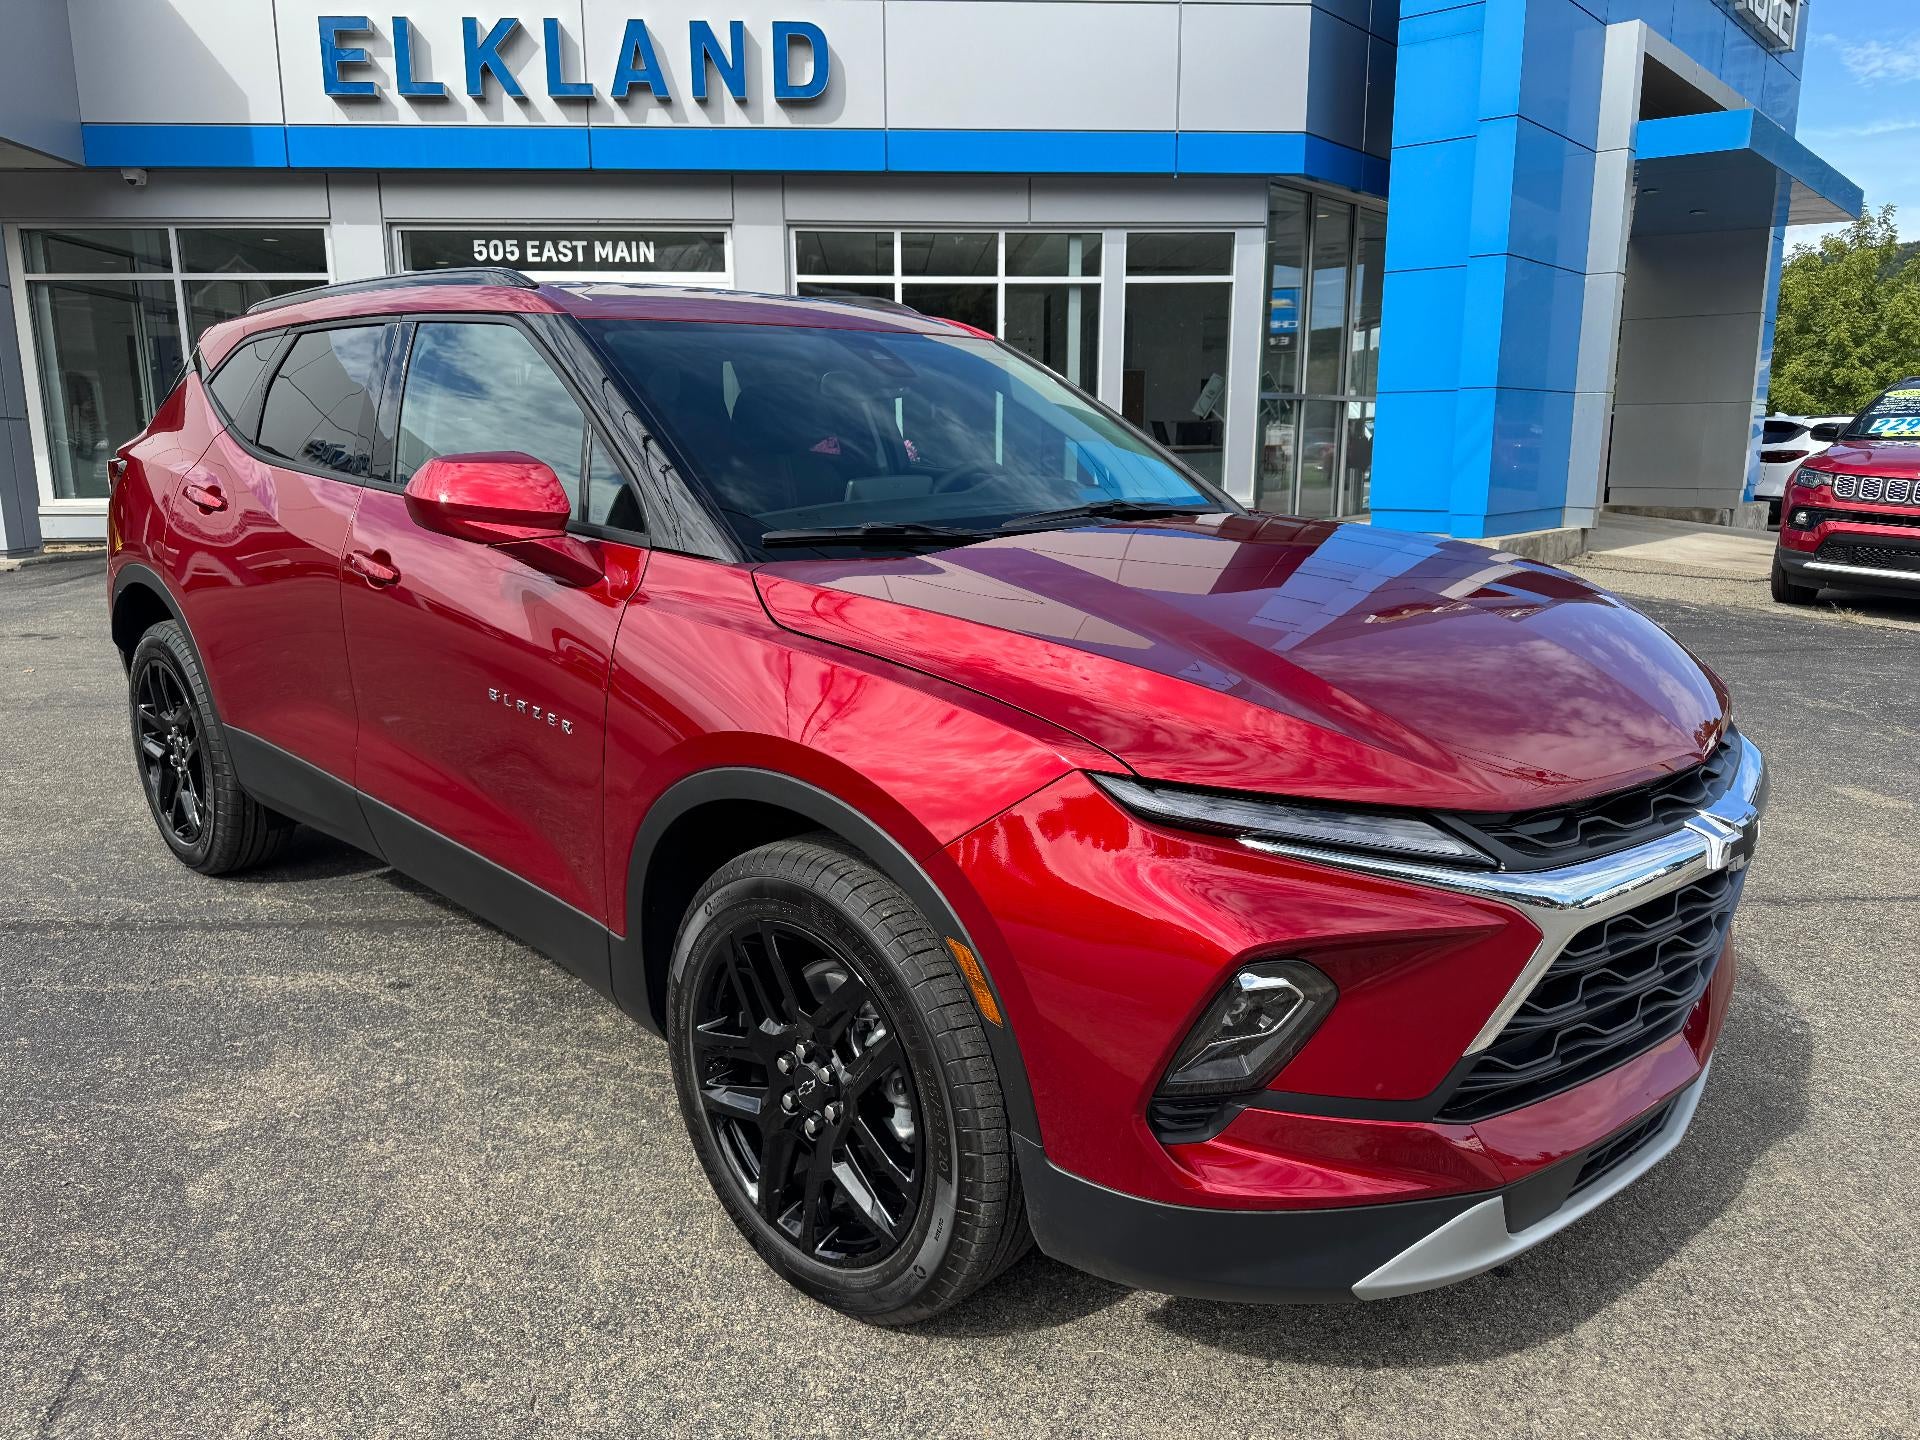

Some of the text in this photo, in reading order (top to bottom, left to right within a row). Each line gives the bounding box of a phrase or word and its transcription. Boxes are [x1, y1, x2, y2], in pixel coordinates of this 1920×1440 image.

[318, 16, 831, 101] ELKLAND
[473, 239, 656, 263] 505 EAST MAIN
[488, 688, 574, 735] BLAZER
